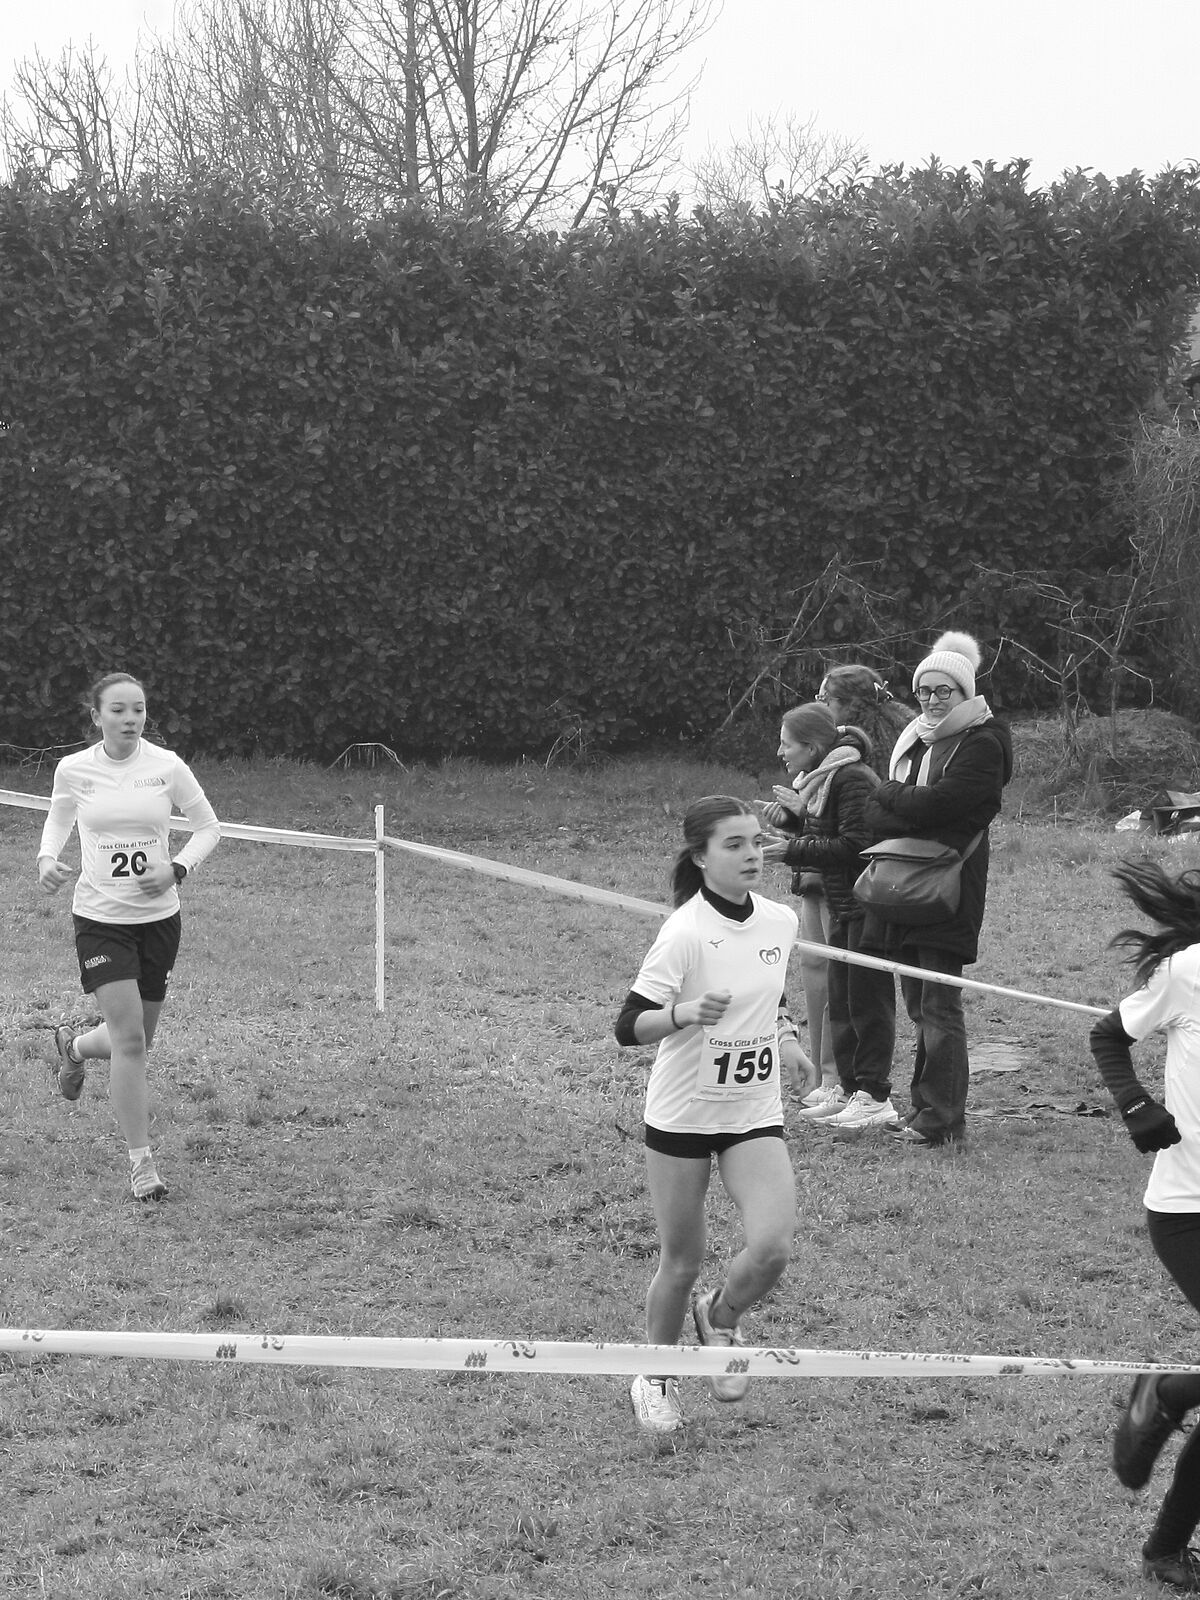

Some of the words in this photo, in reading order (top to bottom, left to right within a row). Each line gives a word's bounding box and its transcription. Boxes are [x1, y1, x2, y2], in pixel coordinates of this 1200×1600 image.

[110, 851, 148, 878] 20
[709, 1037, 733, 1048] Cross
[713, 1046, 773, 1085] 159
